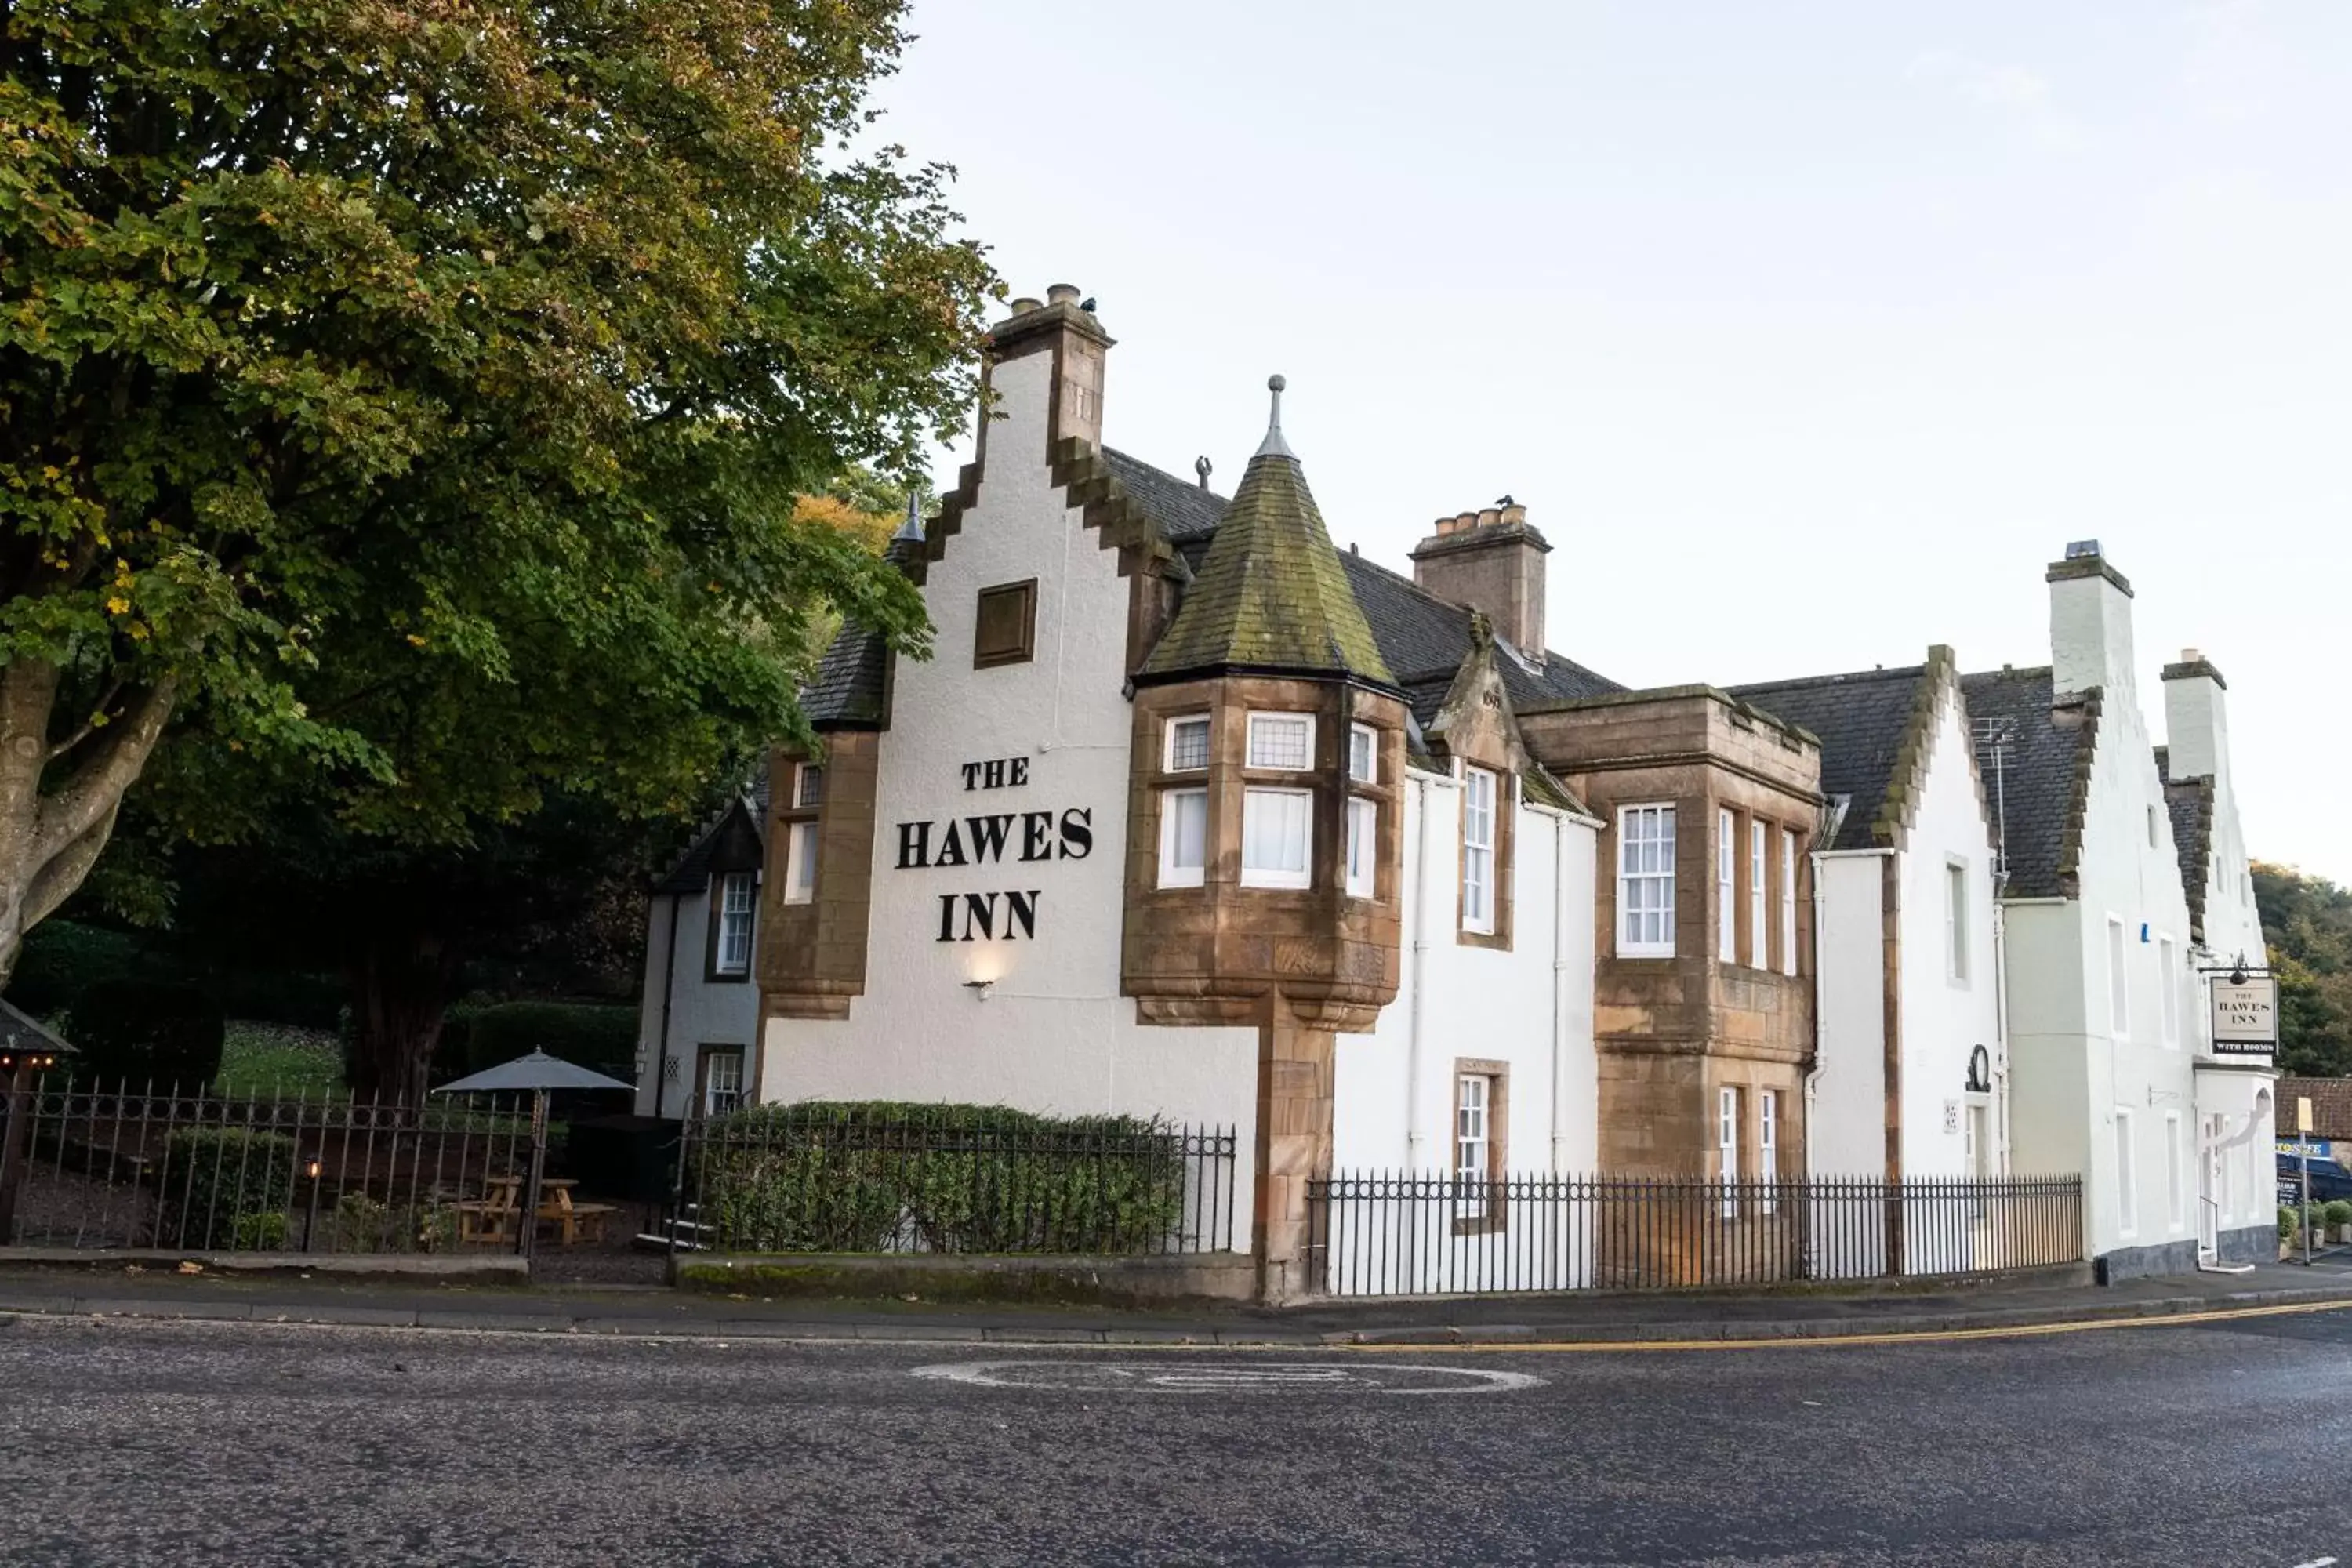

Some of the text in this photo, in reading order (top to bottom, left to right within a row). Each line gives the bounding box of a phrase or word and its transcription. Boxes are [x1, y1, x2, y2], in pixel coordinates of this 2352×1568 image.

[961, 757, 1029, 791] THE
[894, 808, 1093, 869] HAWES
[936, 891, 1041, 941] INN
[2219, 1003, 2270, 1011] HAWES
[2232, 1015, 2257, 1024] INN
